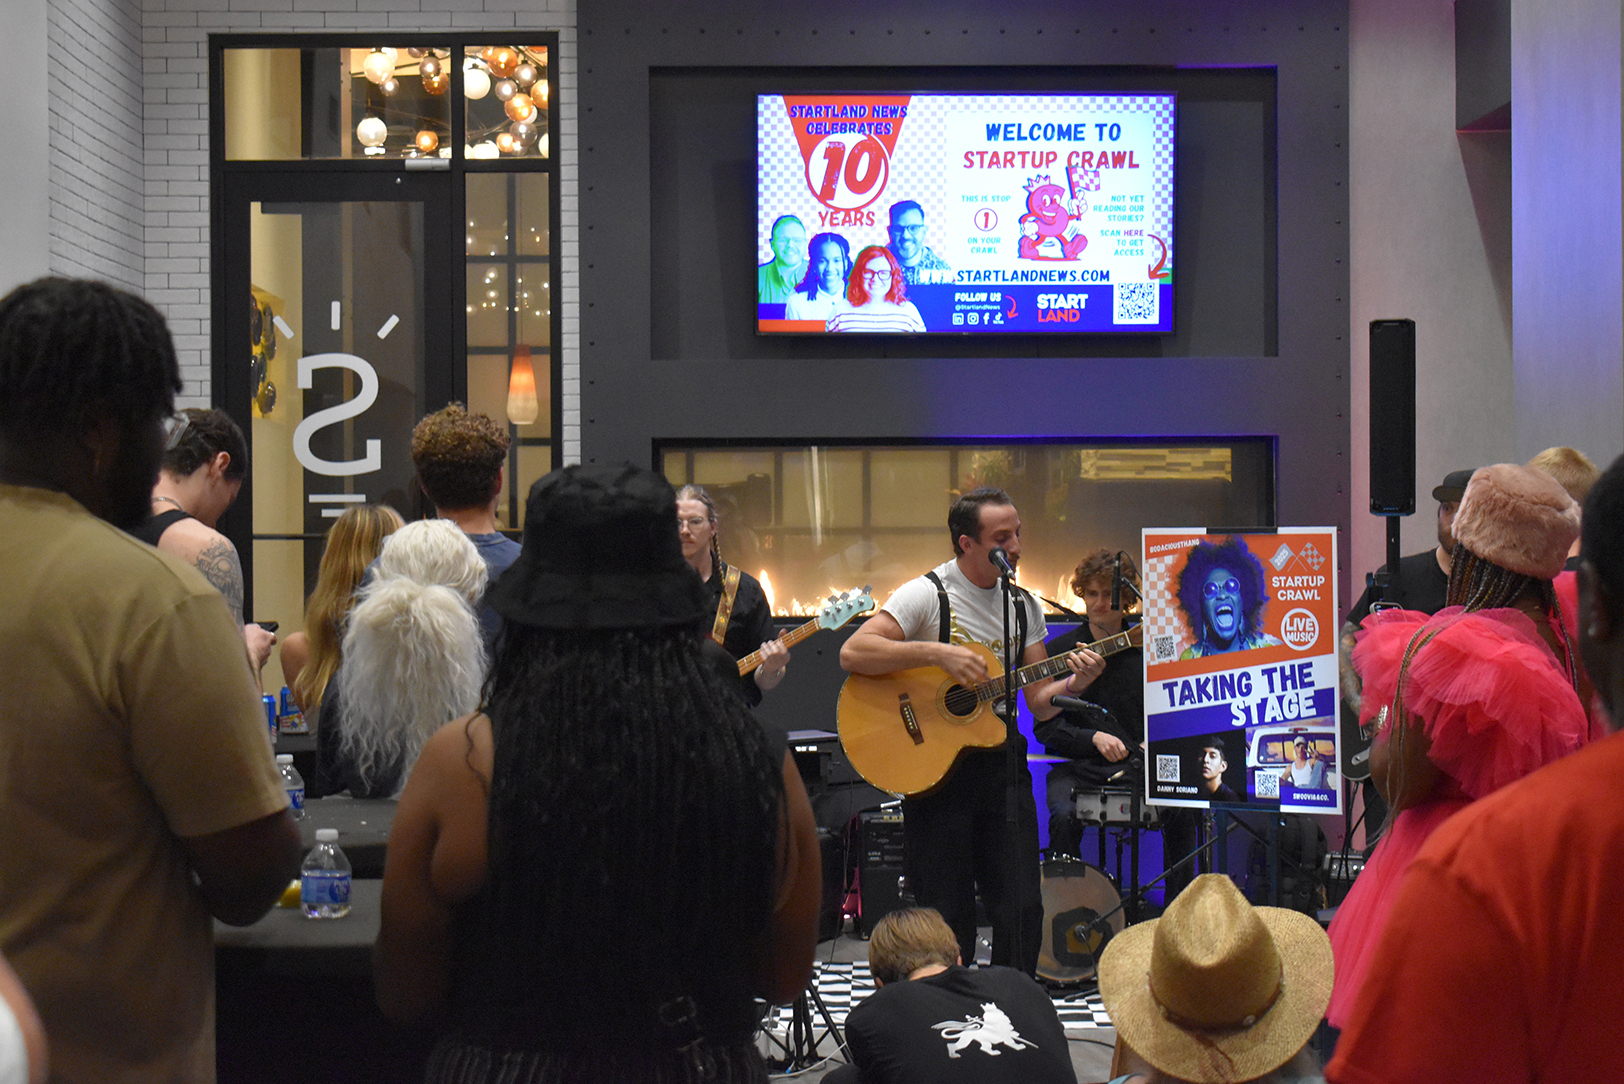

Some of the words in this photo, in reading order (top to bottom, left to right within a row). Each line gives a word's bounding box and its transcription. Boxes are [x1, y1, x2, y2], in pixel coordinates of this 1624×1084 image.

[790, 105, 868, 118] STARTLAND
[872, 105, 908, 118] NEWS
[806, 122, 893, 135] CELEBRATES
[986, 123, 1086, 142] WELCOME
[1095, 123, 1122, 142] TO
[963, 150, 1058, 169] STARTUP
[1067, 150, 1140, 169] CRAWL
[818, 139, 885, 202] 10
[818, 210, 876, 227] YEARS
[984, 211, 990, 229] 1
[1107, 214, 1145, 222] STORIES?
[1100, 229, 1121, 237] SCAN
[1123, 229, 1144, 237] HERE
[957, 270, 1110, 282] STARTLANDNEWS.COM
[954, 292, 988, 302] FOLLOW
[989, 292, 1002, 302] US
[1037, 294, 1089, 309] START
[1038, 309, 1081, 323] LAND
[1274, 548, 1289, 566] 2025
[1272, 575, 1325, 587] STARTUP
[1277, 589, 1321, 601] CRAWL
[1286, 617, 1315, 632] LIVE
[1286, 632, 1315, 642] MUSIC
[1162, 671, 1253, 707] TAKING
[1261, 661, 1316, 694] THE
[1230, 690, 1317, 727] STAGE
[1156, 785, 1175, 793] DANNY
[1175, 786, 1199, 794] SORIANO
